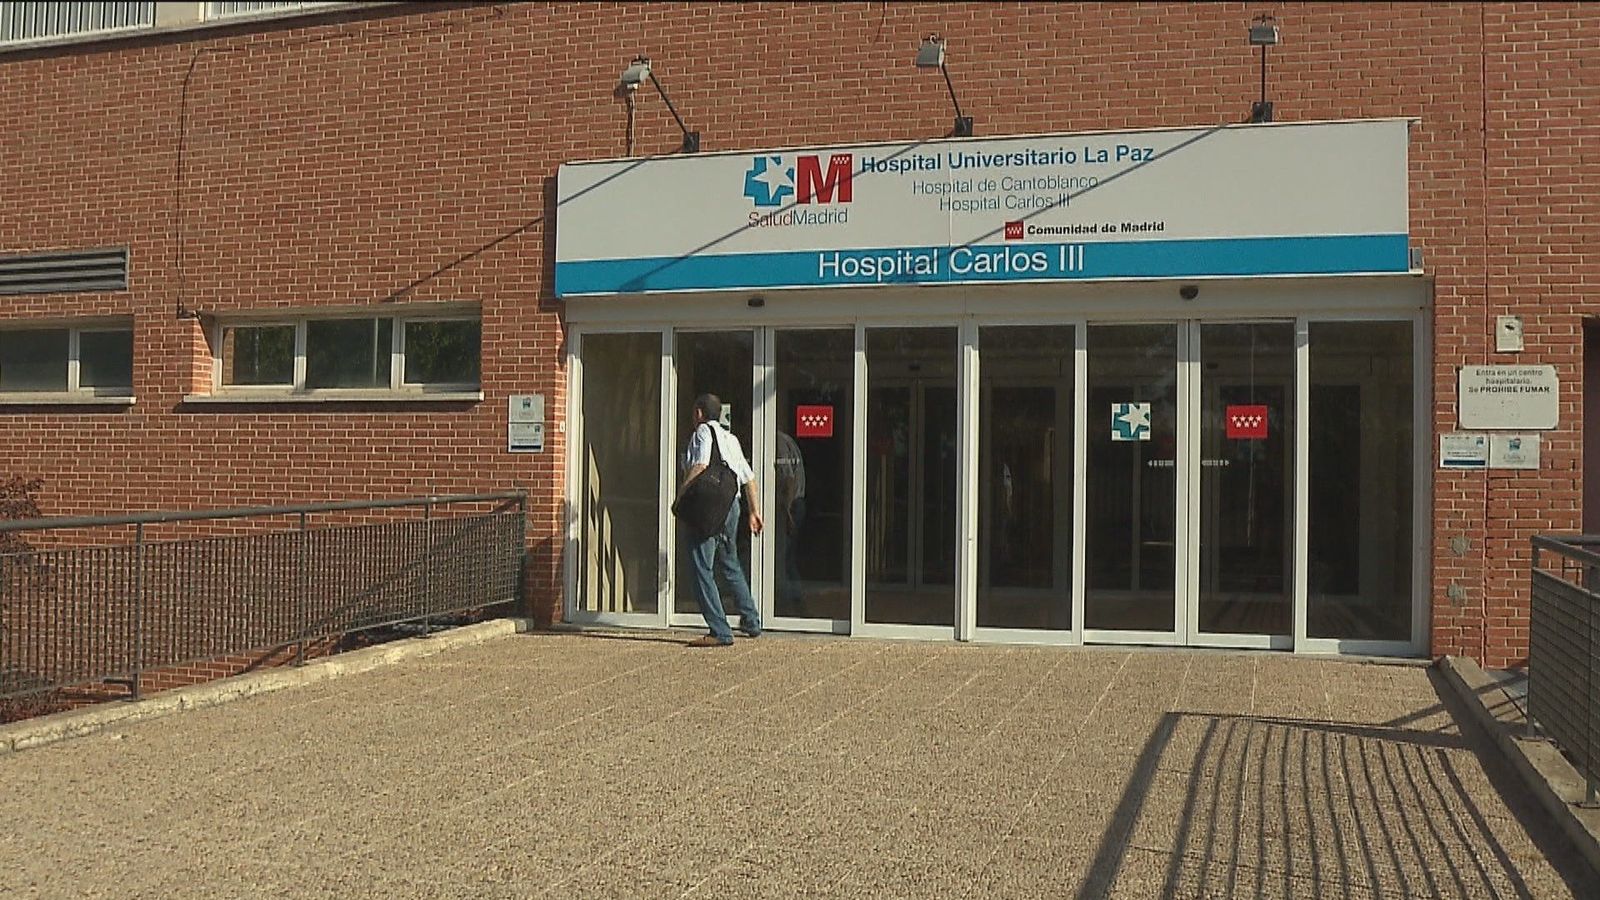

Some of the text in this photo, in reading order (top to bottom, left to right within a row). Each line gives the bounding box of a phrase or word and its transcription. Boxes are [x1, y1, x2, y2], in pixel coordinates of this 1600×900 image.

[862, 145, 1154, 175] Hospital Universitario La Paz
[797, 153, 853, 205] M
[913, 175, 1099, 196] Hospital de Cantoblanco
[940, 193, 1070, 214] Hospital Carlos III
[749, 208, 849, 228] SaludMadrid
[1027, 221, 1165, 235] Comunidad de Madrid
[818, 245, 1085, 282] Hospital Carlos III
